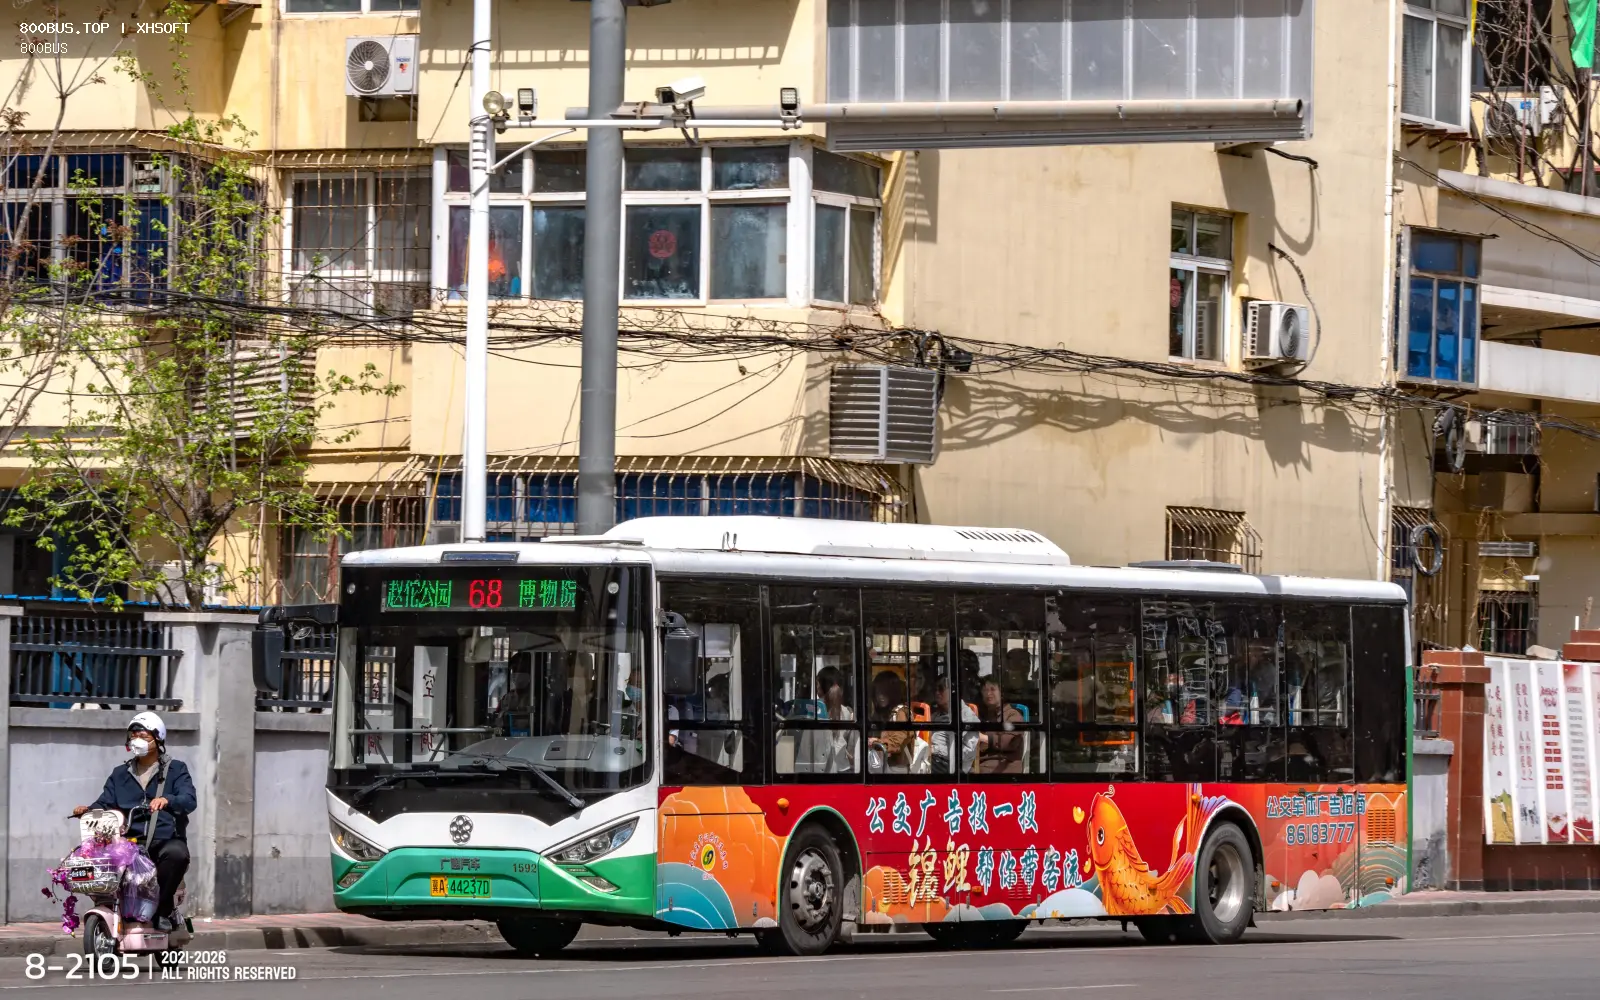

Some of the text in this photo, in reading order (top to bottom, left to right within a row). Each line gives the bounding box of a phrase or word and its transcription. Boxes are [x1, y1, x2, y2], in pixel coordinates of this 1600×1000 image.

[386, 579, 577, 609] 赵佗公园 68 博物院
[865, 789, 1039, 837] 公交广告投一投
[1266, 793, 1366, 818] 公交车体广告招商
[1286, 822, 1356, 845] 86183777
[512, 863, 537, 874] 1592
